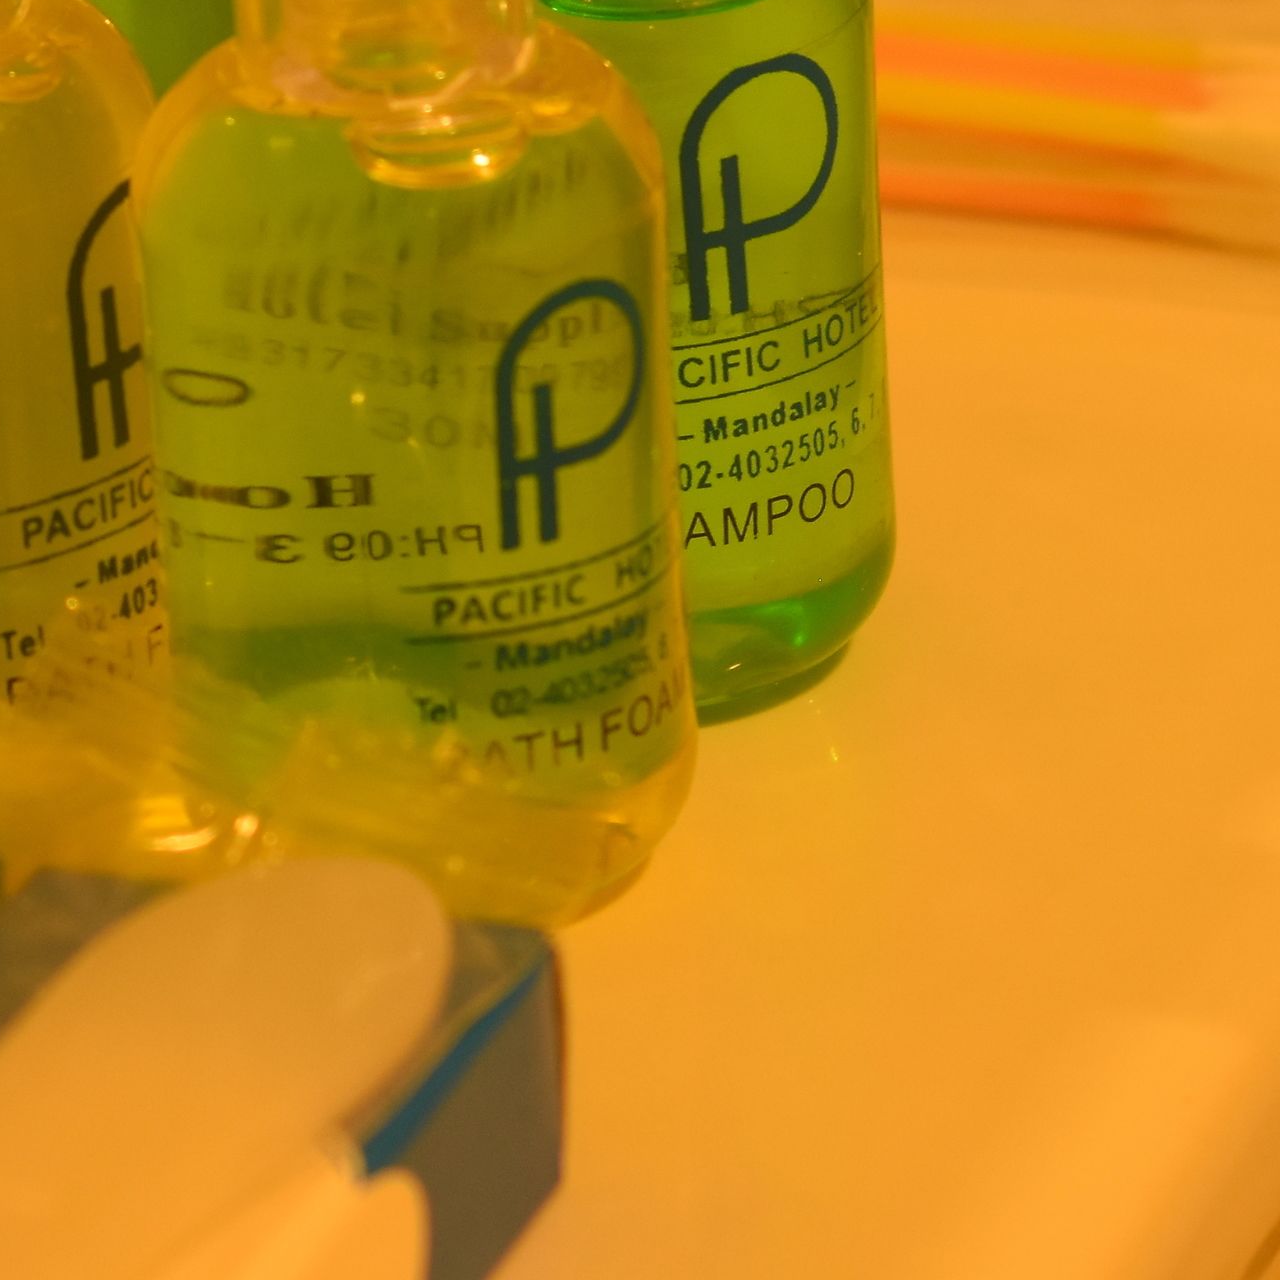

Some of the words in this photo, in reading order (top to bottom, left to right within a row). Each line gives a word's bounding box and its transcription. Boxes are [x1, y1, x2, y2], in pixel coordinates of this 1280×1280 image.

[677, 339, 780, 389] CIFIC
[21, 466, 155, 549] PACIFIC
[682, 467, 855, 550] AMPOO
[431, 571, 587, 627] PACIFIC
[415, 694, 458, 725] Tel
[482, 721, 585, 774] ATH
